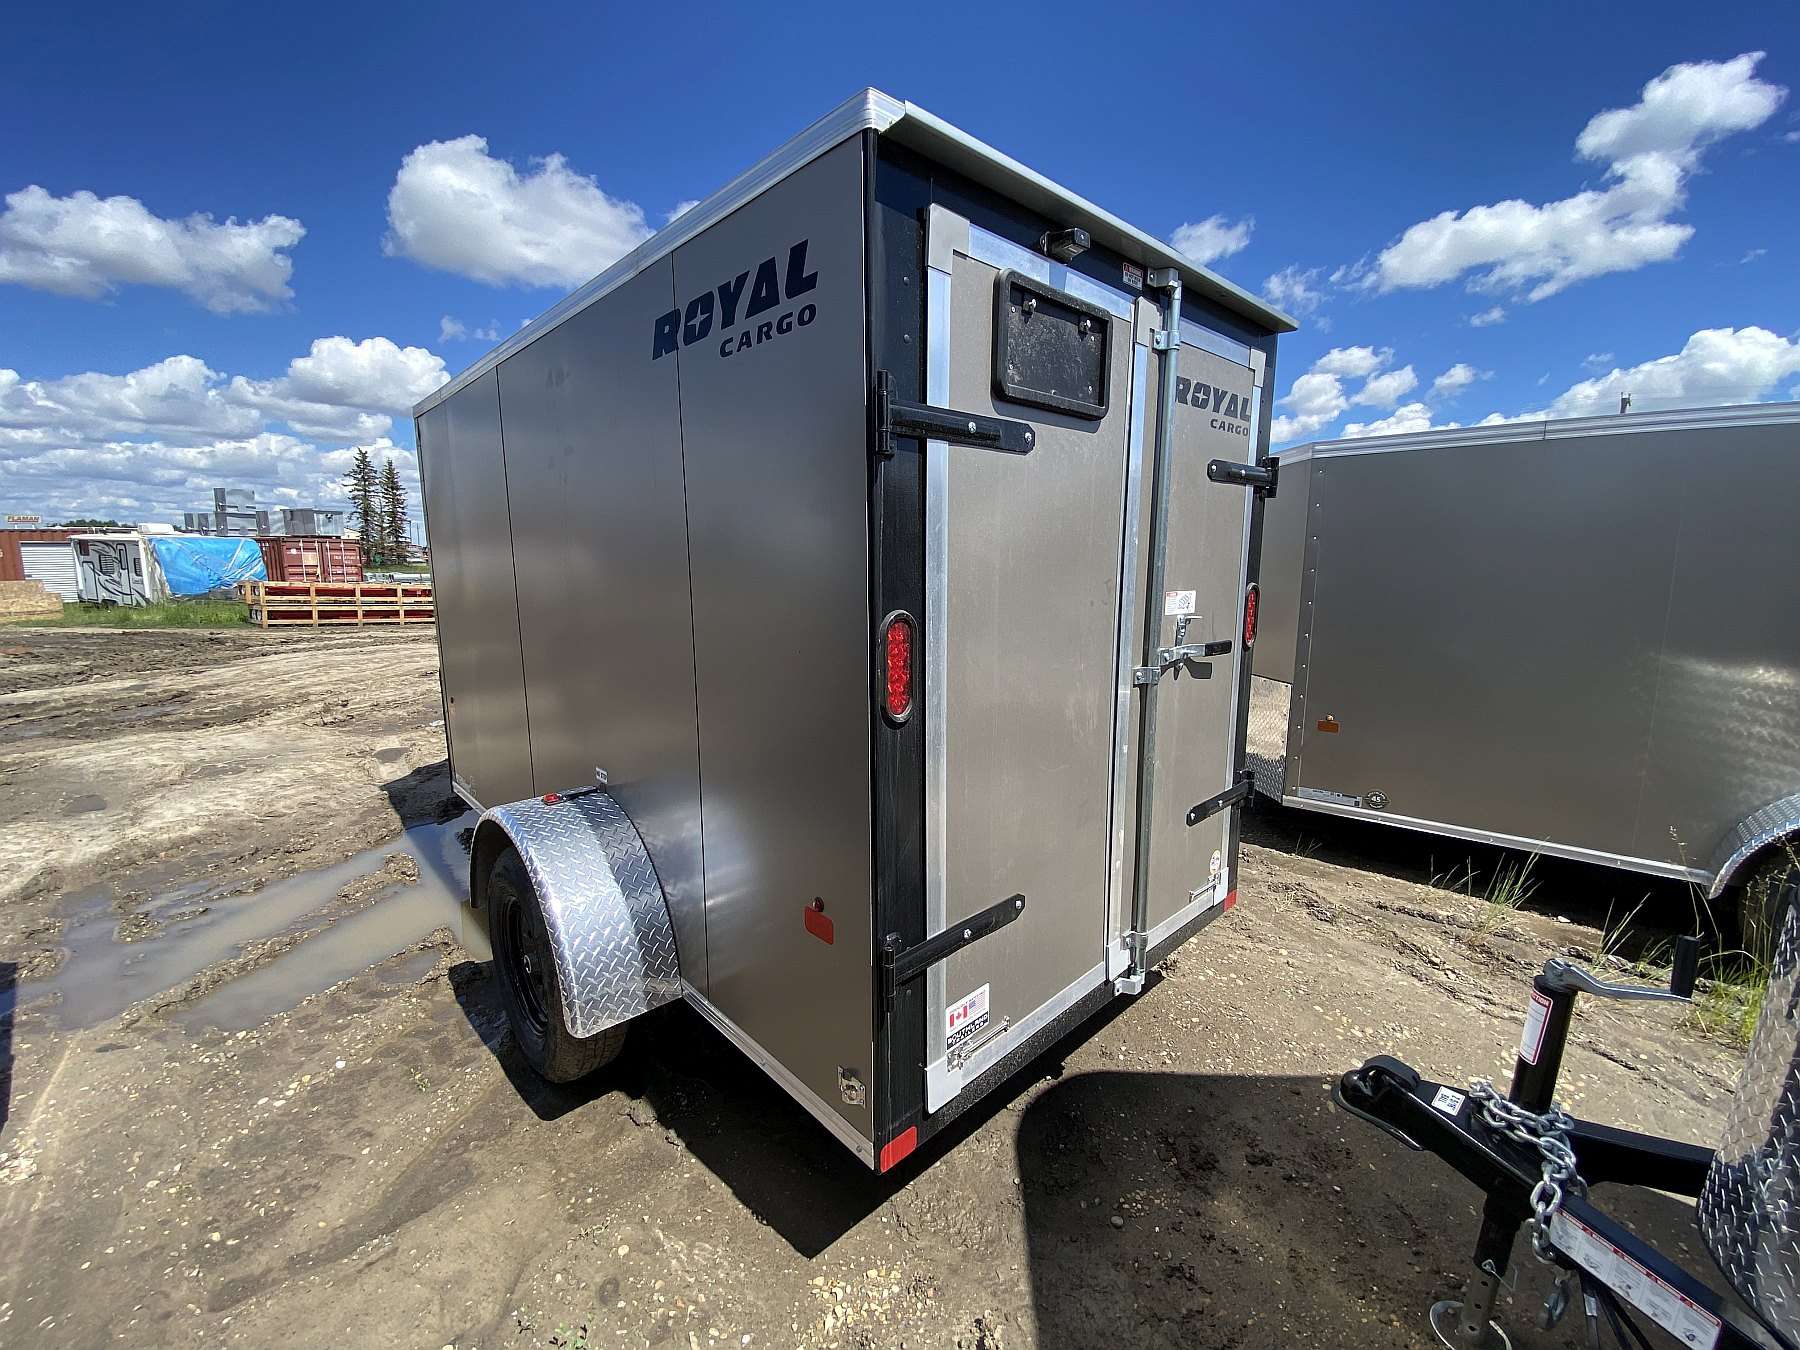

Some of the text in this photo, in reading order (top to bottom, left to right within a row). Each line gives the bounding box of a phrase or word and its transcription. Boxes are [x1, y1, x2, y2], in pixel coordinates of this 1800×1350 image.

[652, 239, 818, 360] ROYAL
[719, 303, 817, 358] CARGO
[1175, 376, 1251, 422] ROYAL
[1210, 419, 1249, 437] CARGO
[948, 1014, 987, 1044] SOUTHLAND
